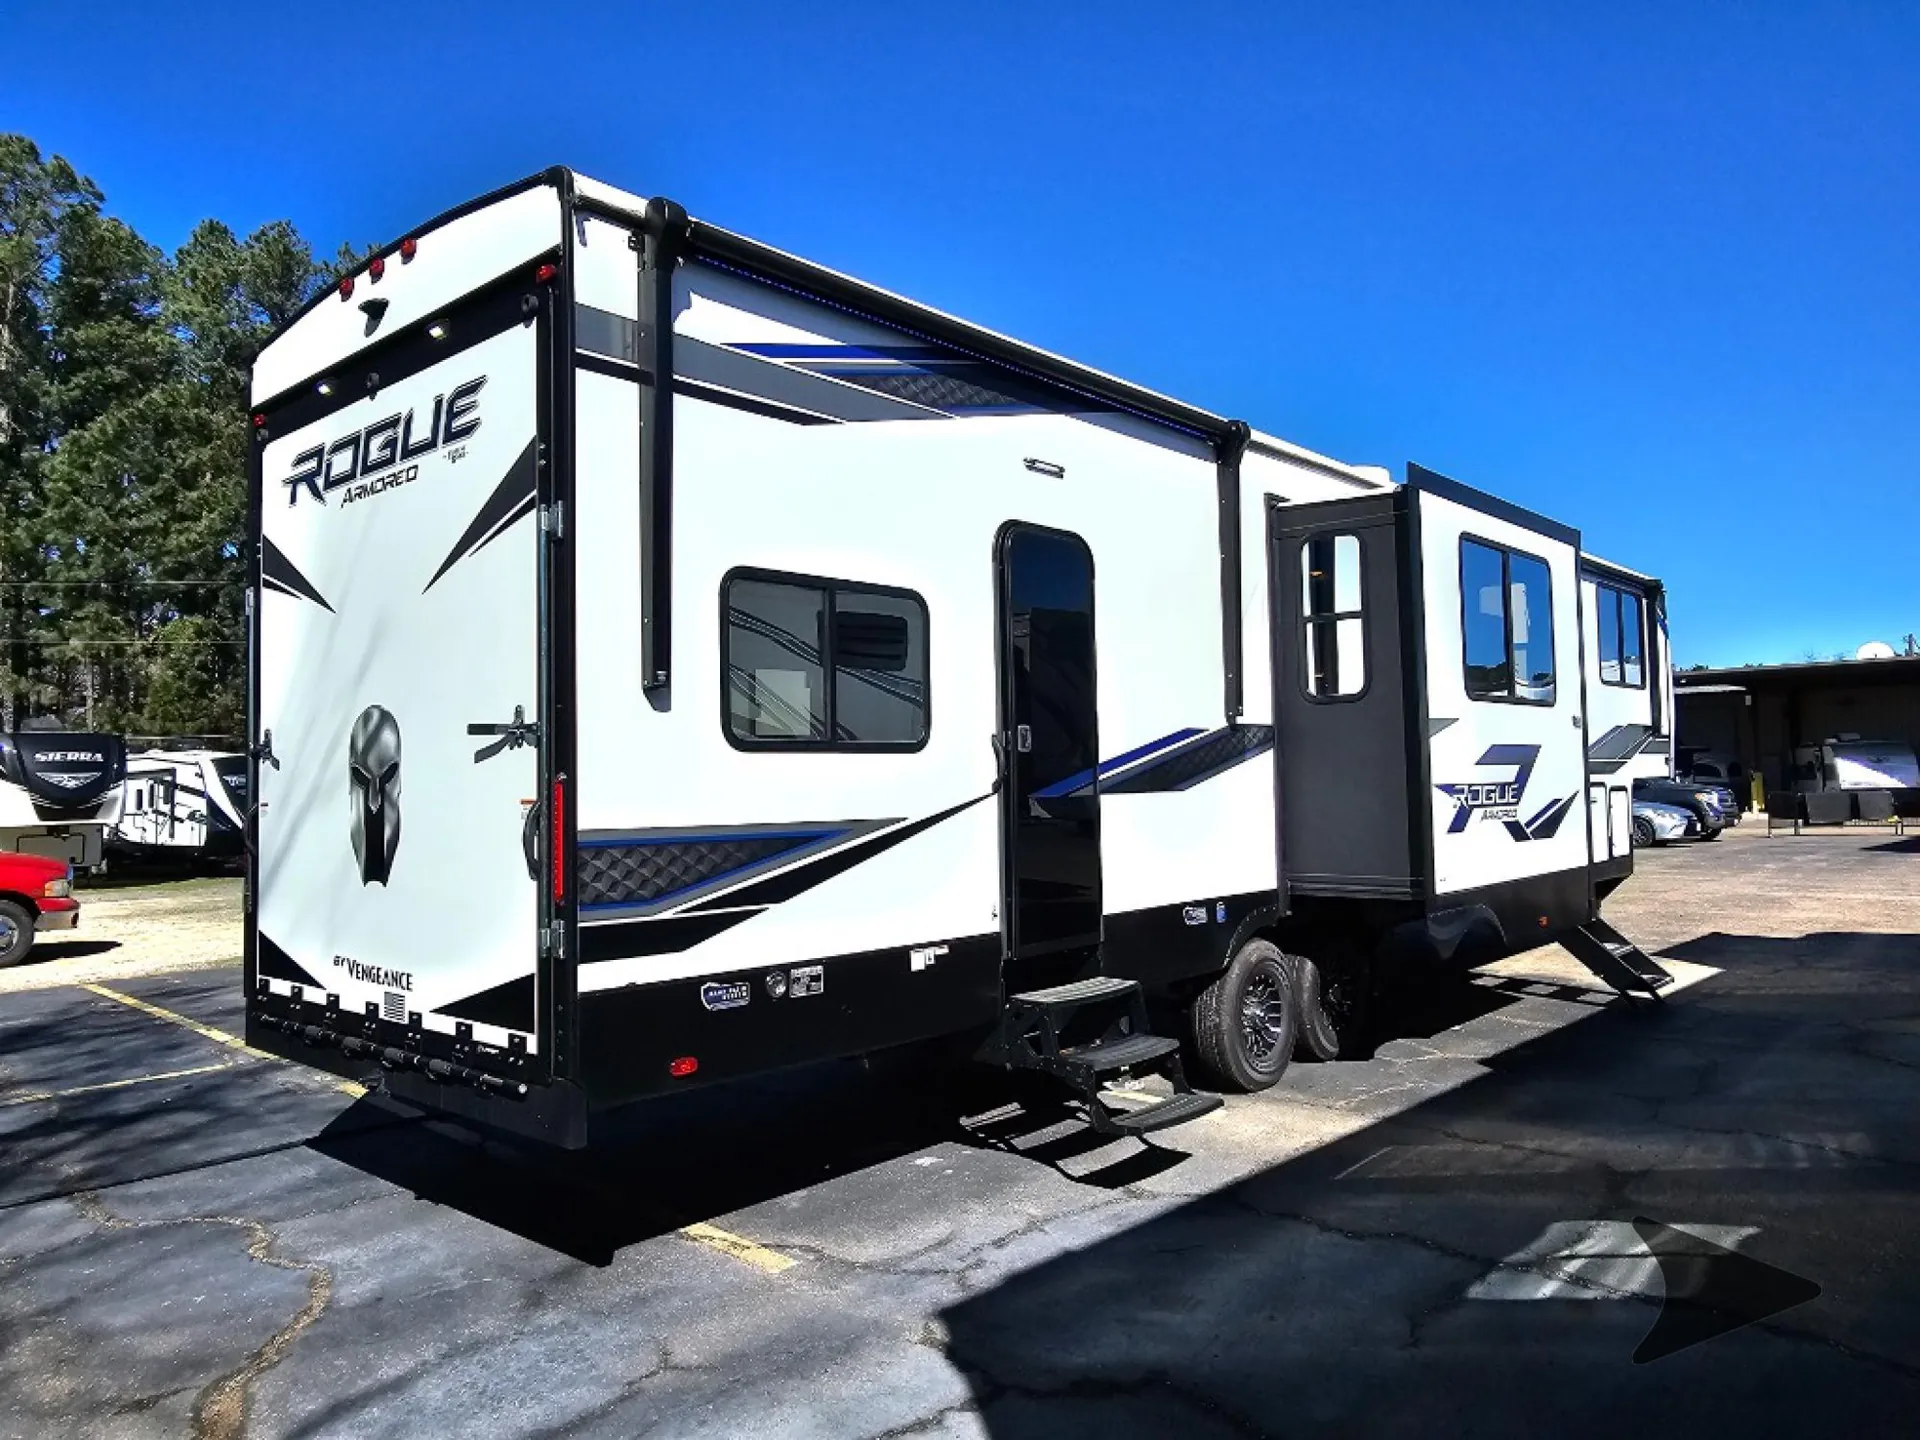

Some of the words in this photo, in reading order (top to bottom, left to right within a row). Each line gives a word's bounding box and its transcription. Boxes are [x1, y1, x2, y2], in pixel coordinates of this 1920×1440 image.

[281, 375, 489, 507] ROGUE
[340, 465, 419, 508] ARMORED
[34, 751, 104, 762] SIERRA
[1451, 784, 1519, 808] ROGUE
[346, 957, 413, 992] VENGEANCE
